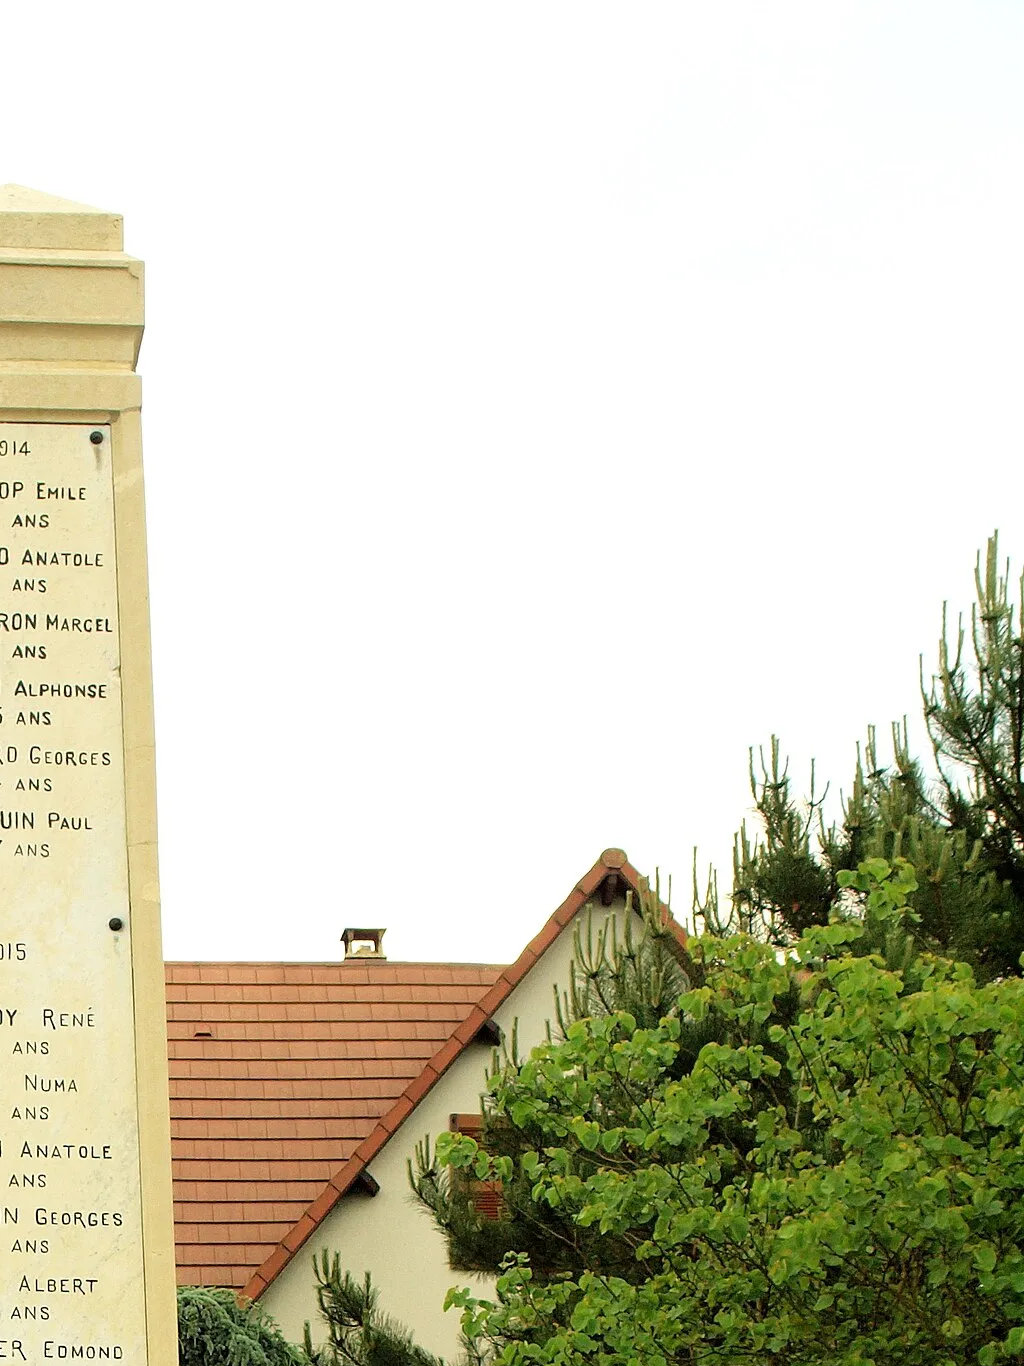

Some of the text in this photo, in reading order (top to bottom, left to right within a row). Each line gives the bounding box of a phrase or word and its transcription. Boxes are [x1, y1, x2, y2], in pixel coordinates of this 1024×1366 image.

[37, 482, 86, 500] EMILE
[11, 514, 49, 528] ANS
[22, 549, 103, 567] ANATOLE
[12, 579, 46, 593] ANS
[46, 614, 112, 632] MARCEL
[12, 645, 46, 659] ANS
[15, 680, 107, 698] ALPHONSE
[16, 712, 51, 725] ANS
[30, 746, 110, 766] GEORGES
[16, 778, 52, 791] ANS
[48, 812, 92, 830] PAUL
[14, 844, 49, 857] ANS
[43, 1007, 94, 1030] RENÉ
[13, 1042, 49, 1054] ANS
[25, 1074, 77, 1092] NUMA
[12, 1107, 49, 1120] ANS
[21, 1141, 112, 1159] ANATOLE
[9, 1174, 46, 1187] ANS
[36, 1208, 122, 1228] GEORGES
[11, 1239, 48, 1253] ANS
[19, 1275, 98, 1295] ALBERT
[11, 1306, 49, 1320] ANS
[44, 1341, 123, 1359] EDMOND
